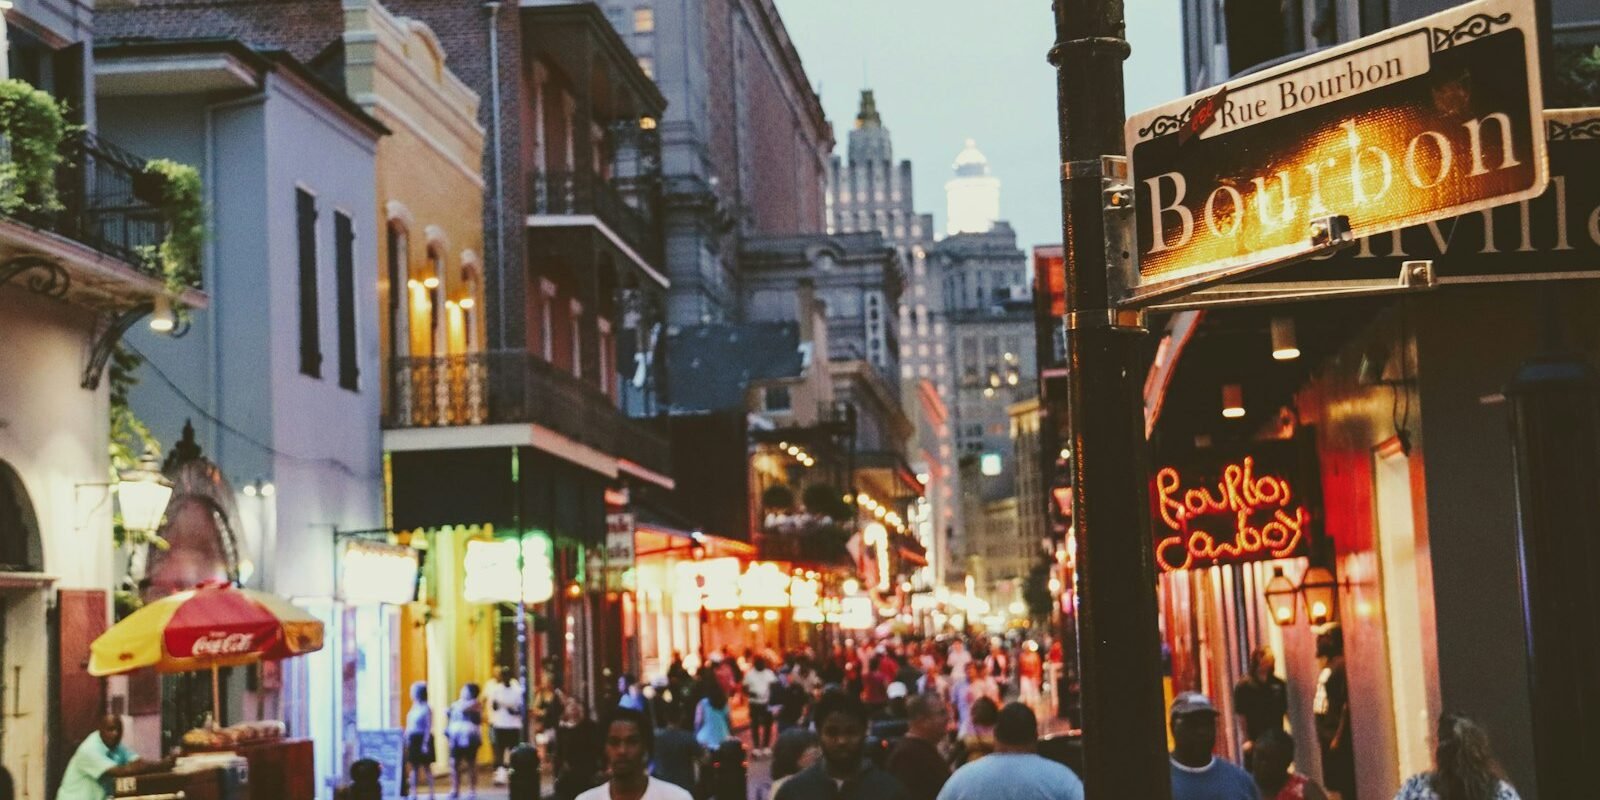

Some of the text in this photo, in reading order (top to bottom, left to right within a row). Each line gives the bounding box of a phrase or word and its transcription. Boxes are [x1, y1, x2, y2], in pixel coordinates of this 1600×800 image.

[1220, 99, 1267, 129] Rue
[1278, 56, 1404, 111] Bourbon
[1143, 110, 1522, 255] Bourbon
